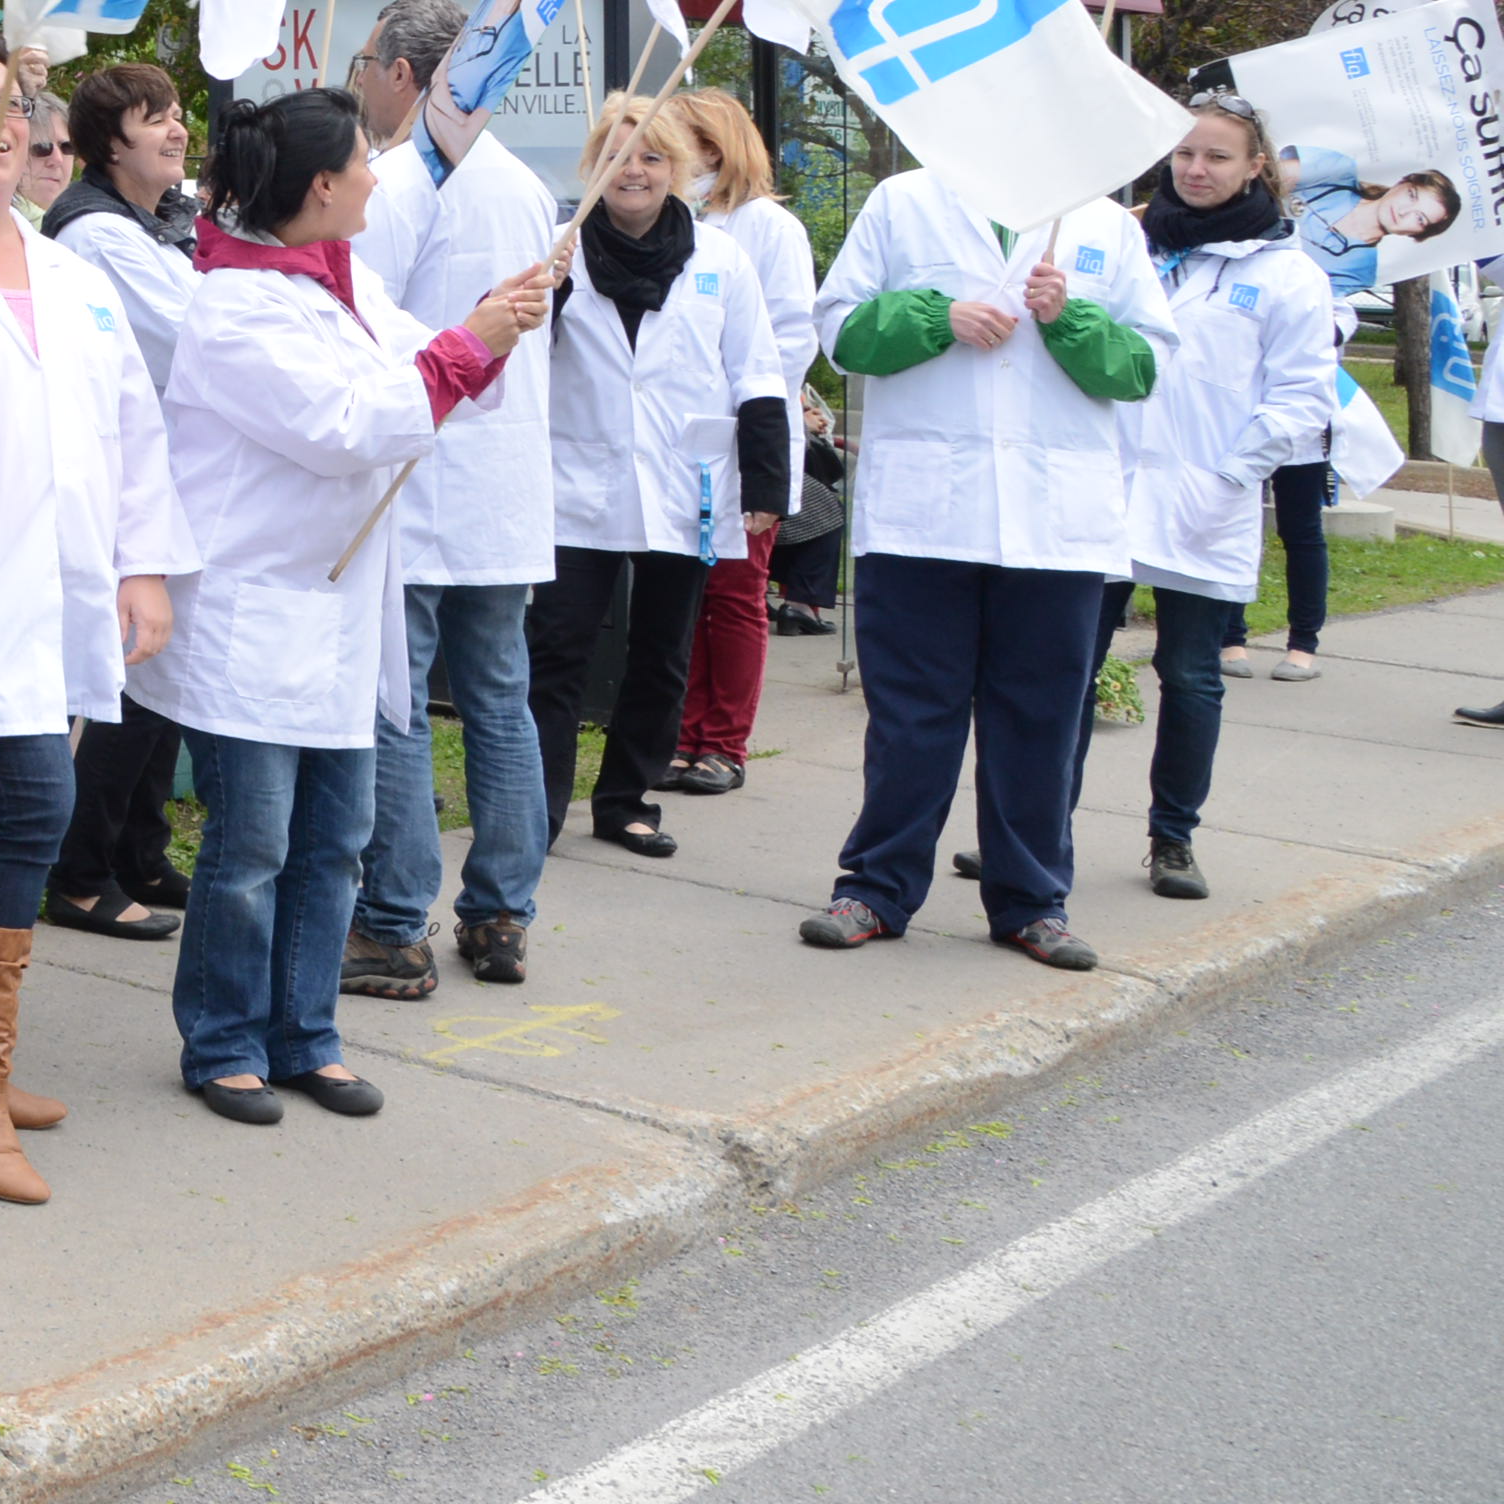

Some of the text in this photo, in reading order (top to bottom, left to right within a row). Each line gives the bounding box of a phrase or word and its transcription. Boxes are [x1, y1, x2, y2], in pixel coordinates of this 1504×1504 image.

[1444, 15, 1486, 84] Ça
[1424, 26, 1470, 159] LAISSEZ-NOUS
[1076, 248, 1104, 275] fiq
[695, 274, 720, 296] fiq
[1231, 286, 1259, 311] fiq
